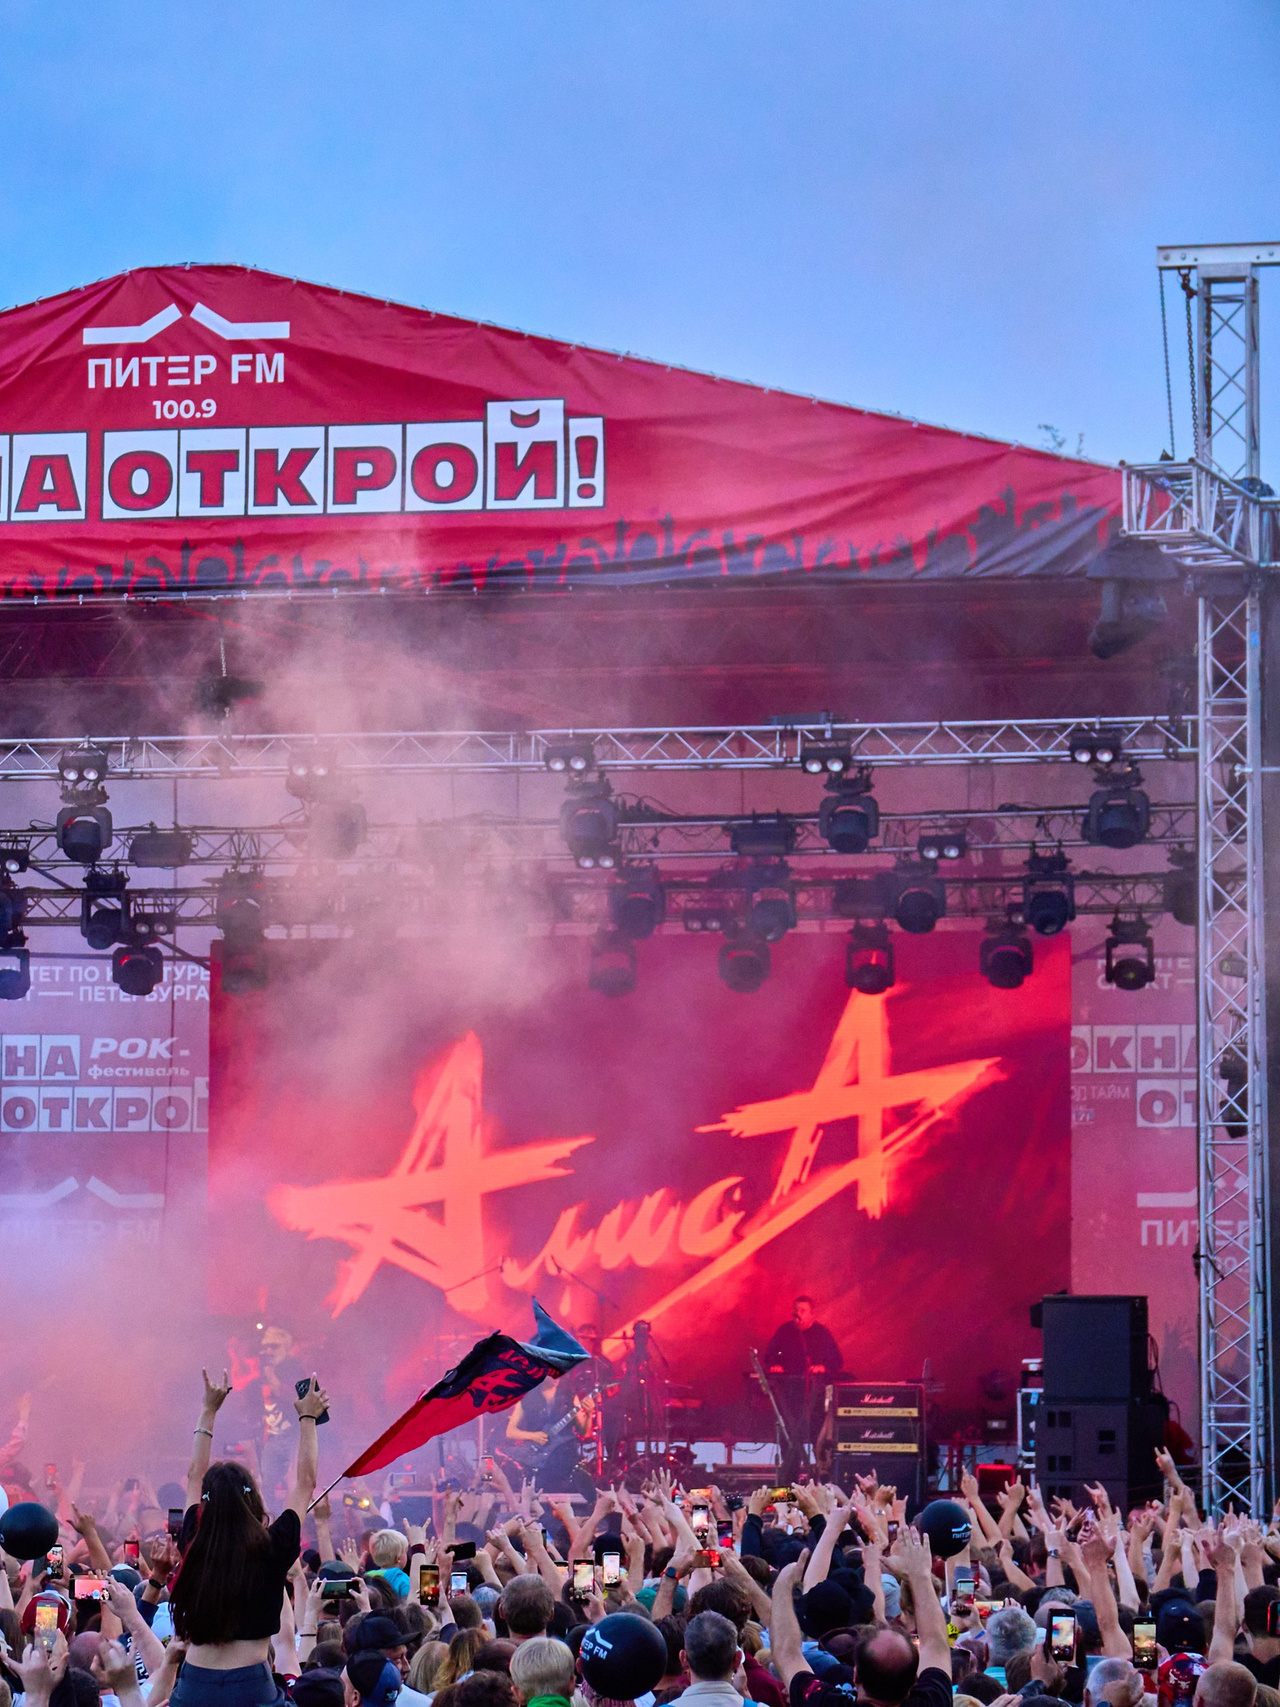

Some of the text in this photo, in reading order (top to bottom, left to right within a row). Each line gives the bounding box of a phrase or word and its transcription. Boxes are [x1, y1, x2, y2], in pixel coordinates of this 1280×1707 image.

[87, 352, 285, 389] ПИТЕР FM
[152, 398, 217, 420] 100.9
[105, 406, 601, 512] ОТКРОЙ!
[70, 965, 99, 982] ПО
[87, 1063, 191, 1080] фестиваль
[593, 1645, 608, 1660] FM
